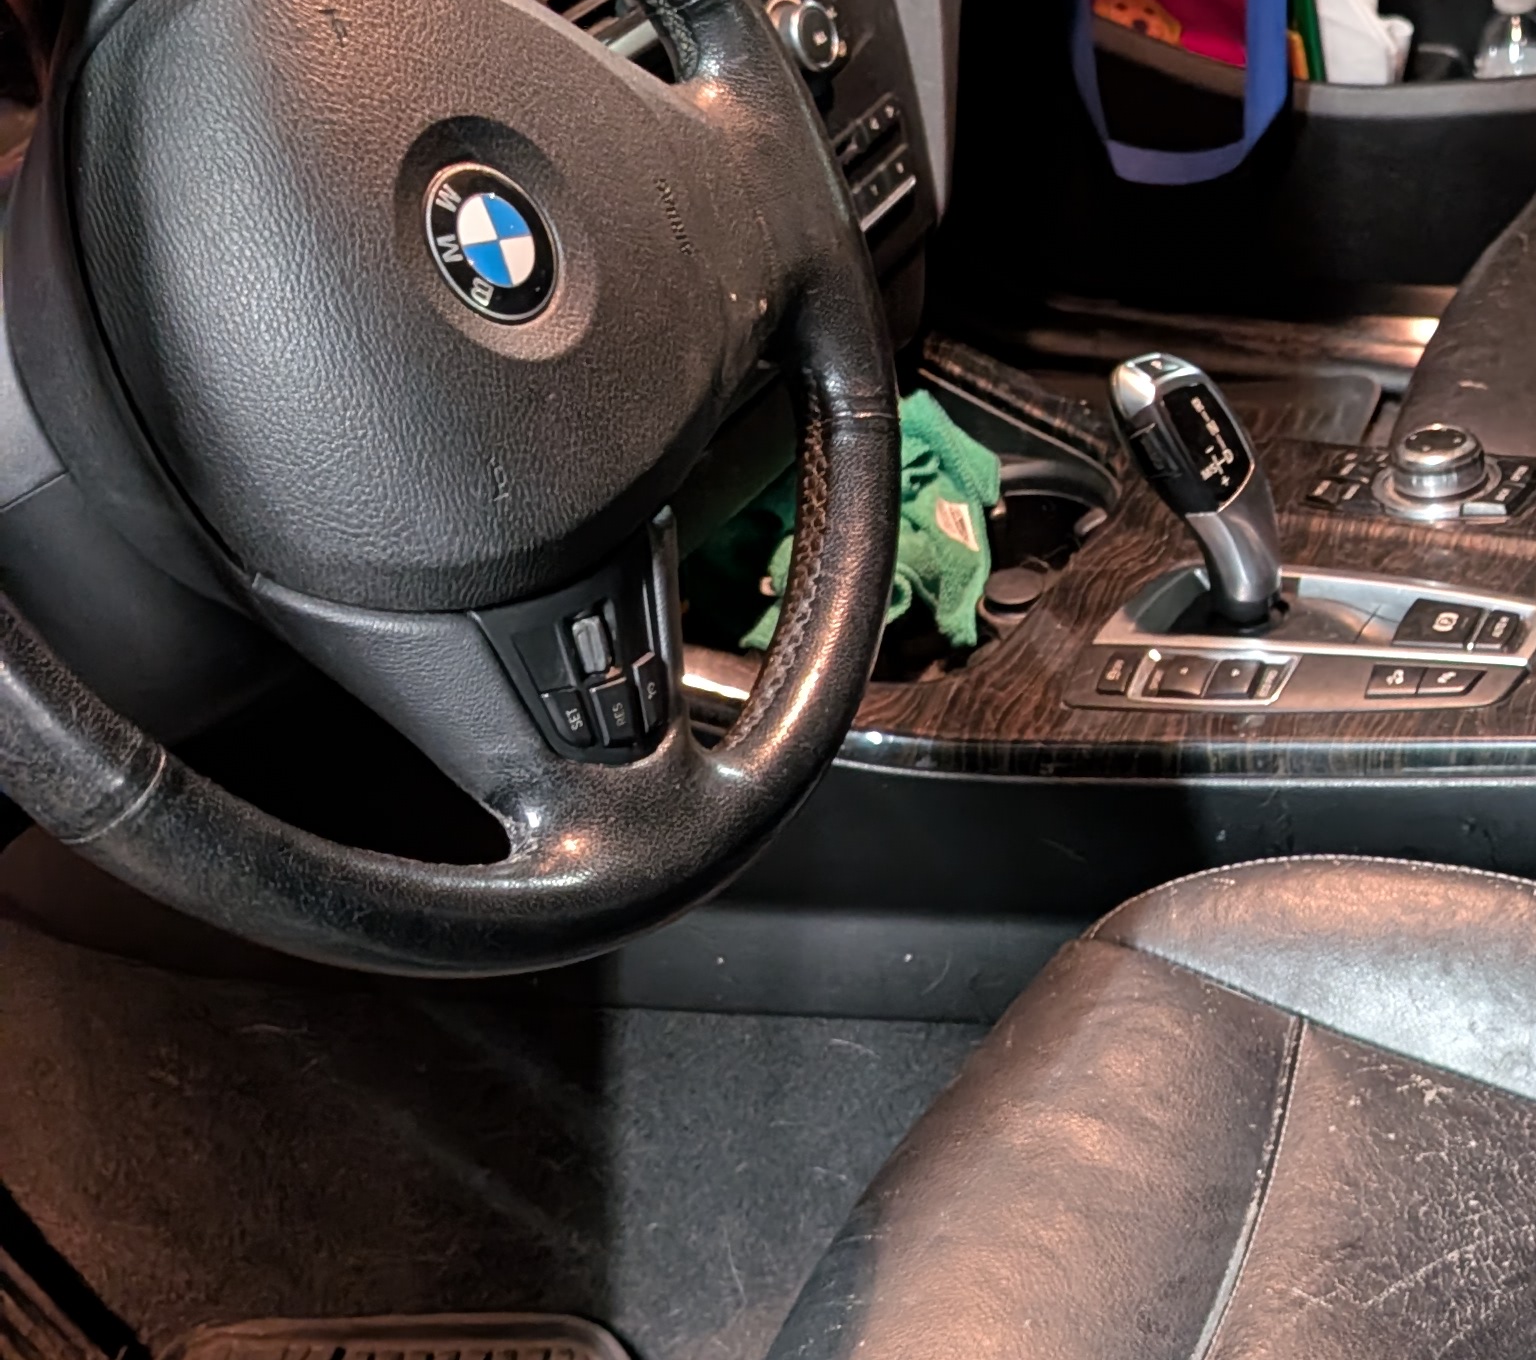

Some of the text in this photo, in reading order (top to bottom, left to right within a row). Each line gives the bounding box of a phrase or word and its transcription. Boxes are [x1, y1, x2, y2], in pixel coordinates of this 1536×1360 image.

[435, 183, 495, 307] BMW
[565, 707, 584, 731] SET
[611, 702, 626, 727] RES
